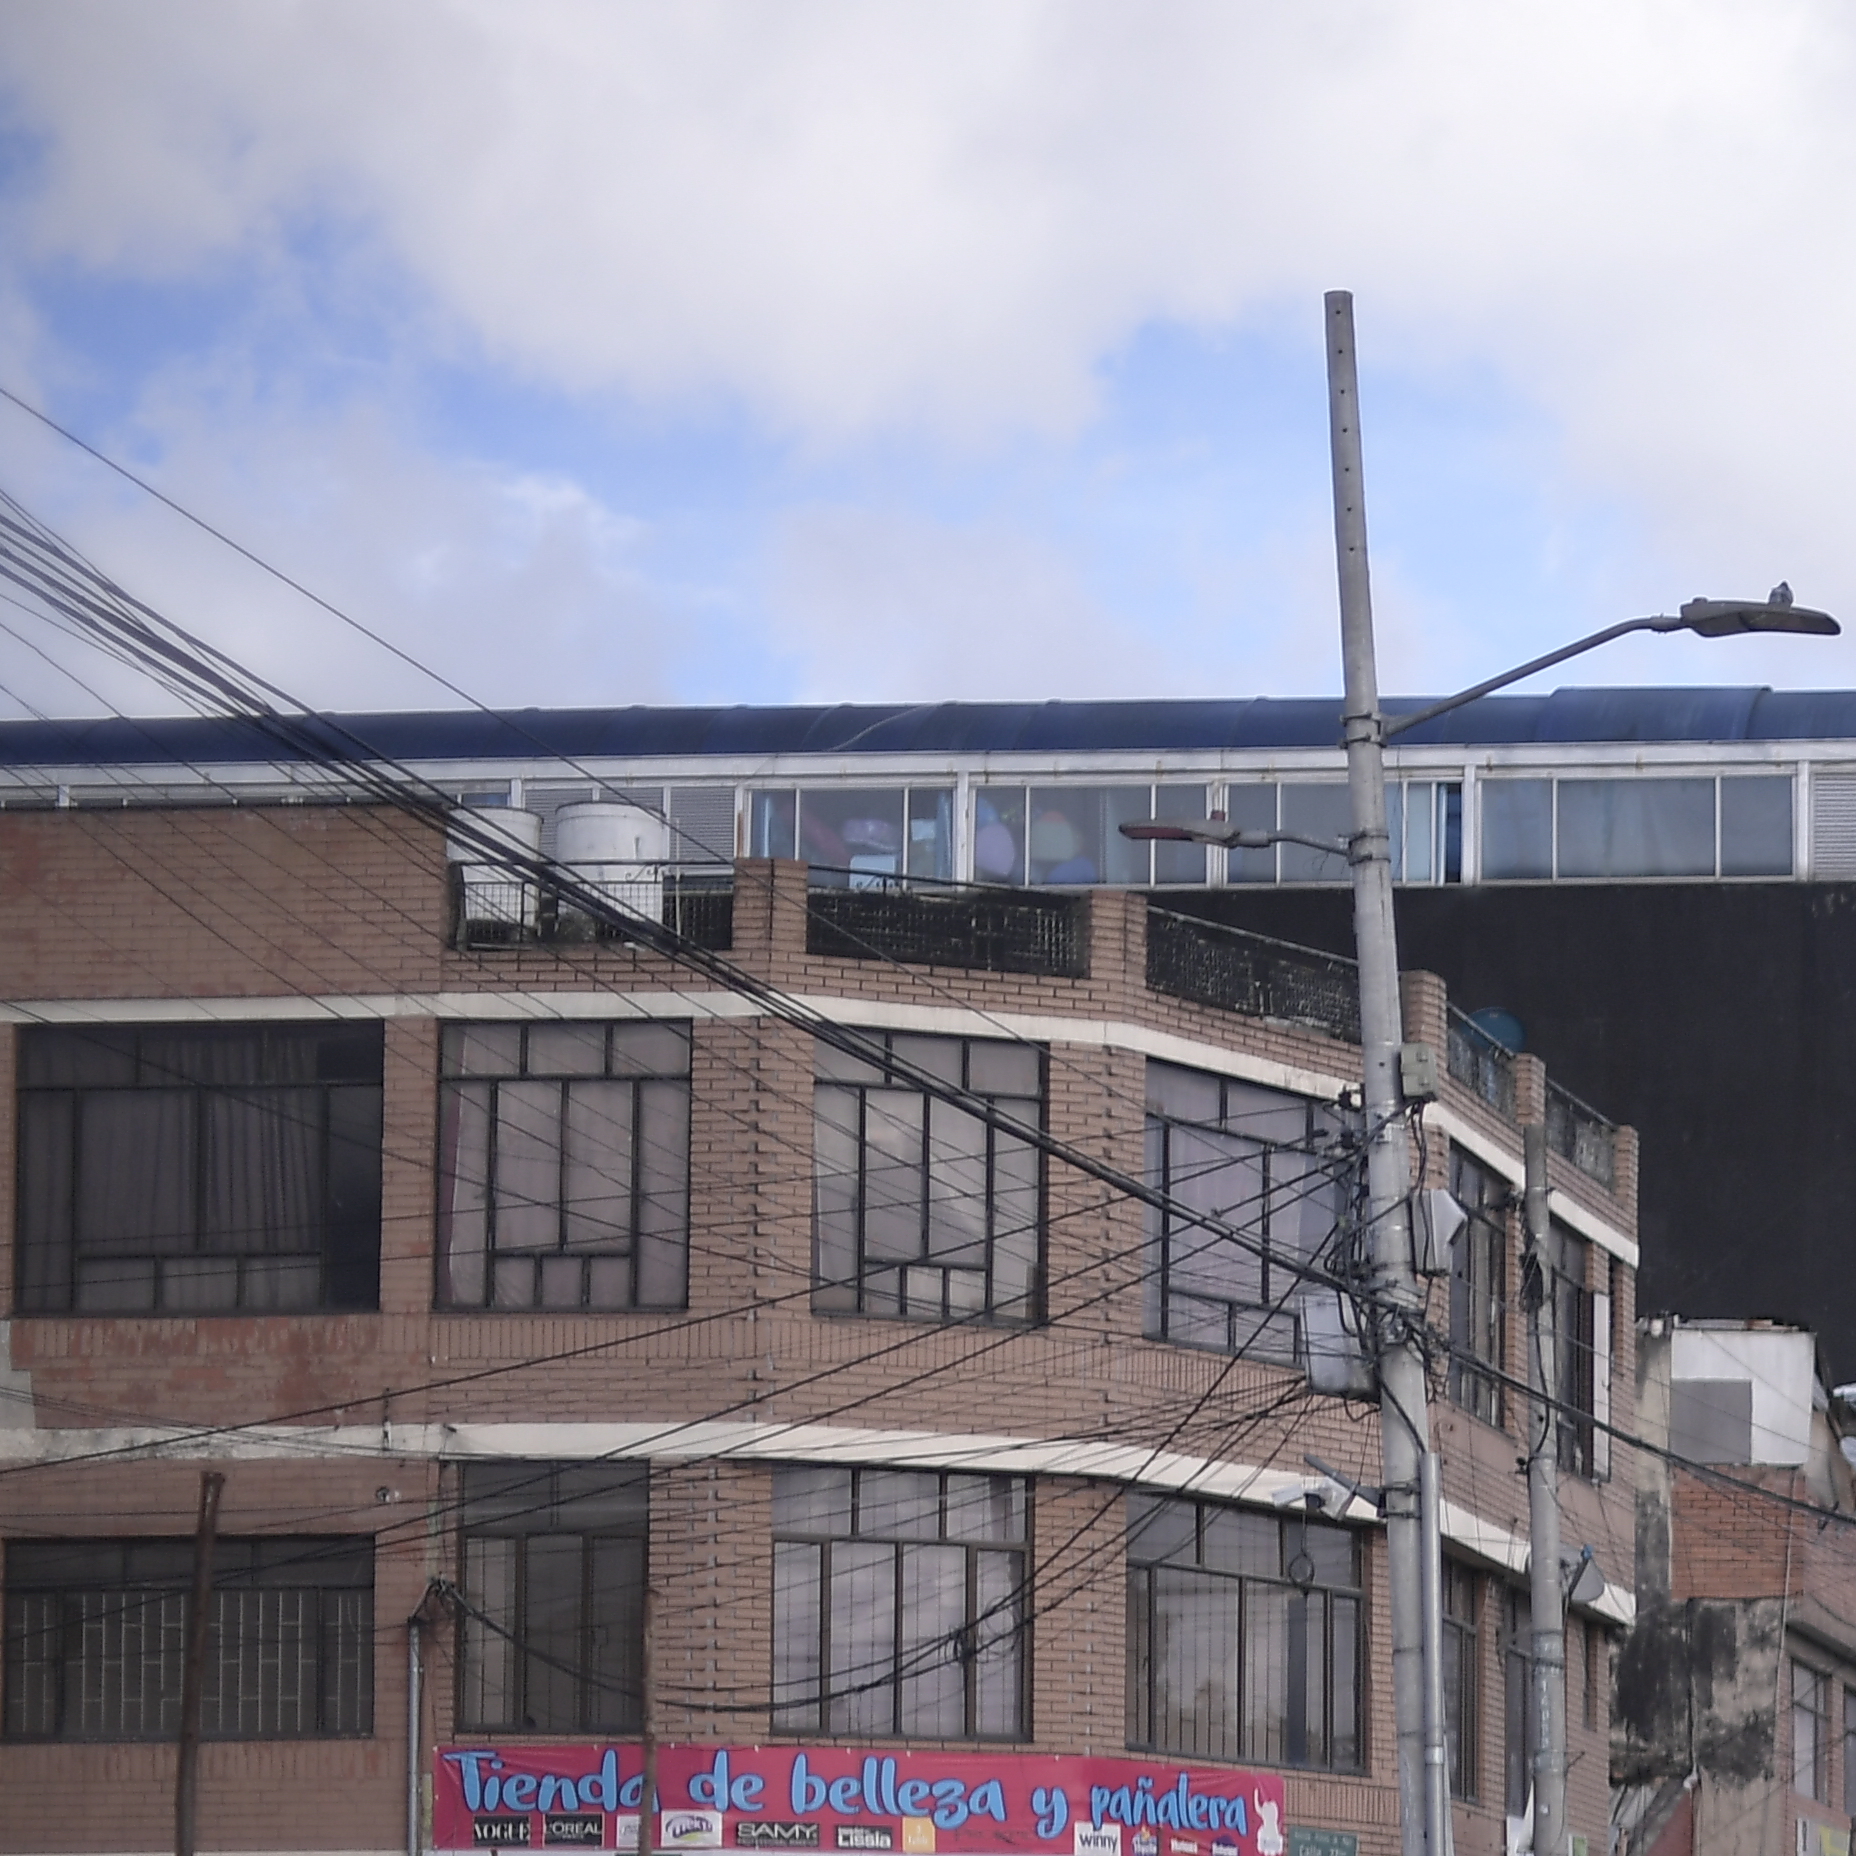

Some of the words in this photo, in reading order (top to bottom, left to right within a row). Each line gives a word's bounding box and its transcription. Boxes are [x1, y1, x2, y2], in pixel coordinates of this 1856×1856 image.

[442, 1748, 660, 1814] Tienda
[687, 1748, 765, 1813] de
[790, 1752, 1007, 1831] belleza
[1031, 1785, 1069, 1840] y
[1090, 1770, 1249, 1837] pañalera
[474, 1822, 530, 1841] VOGUE
